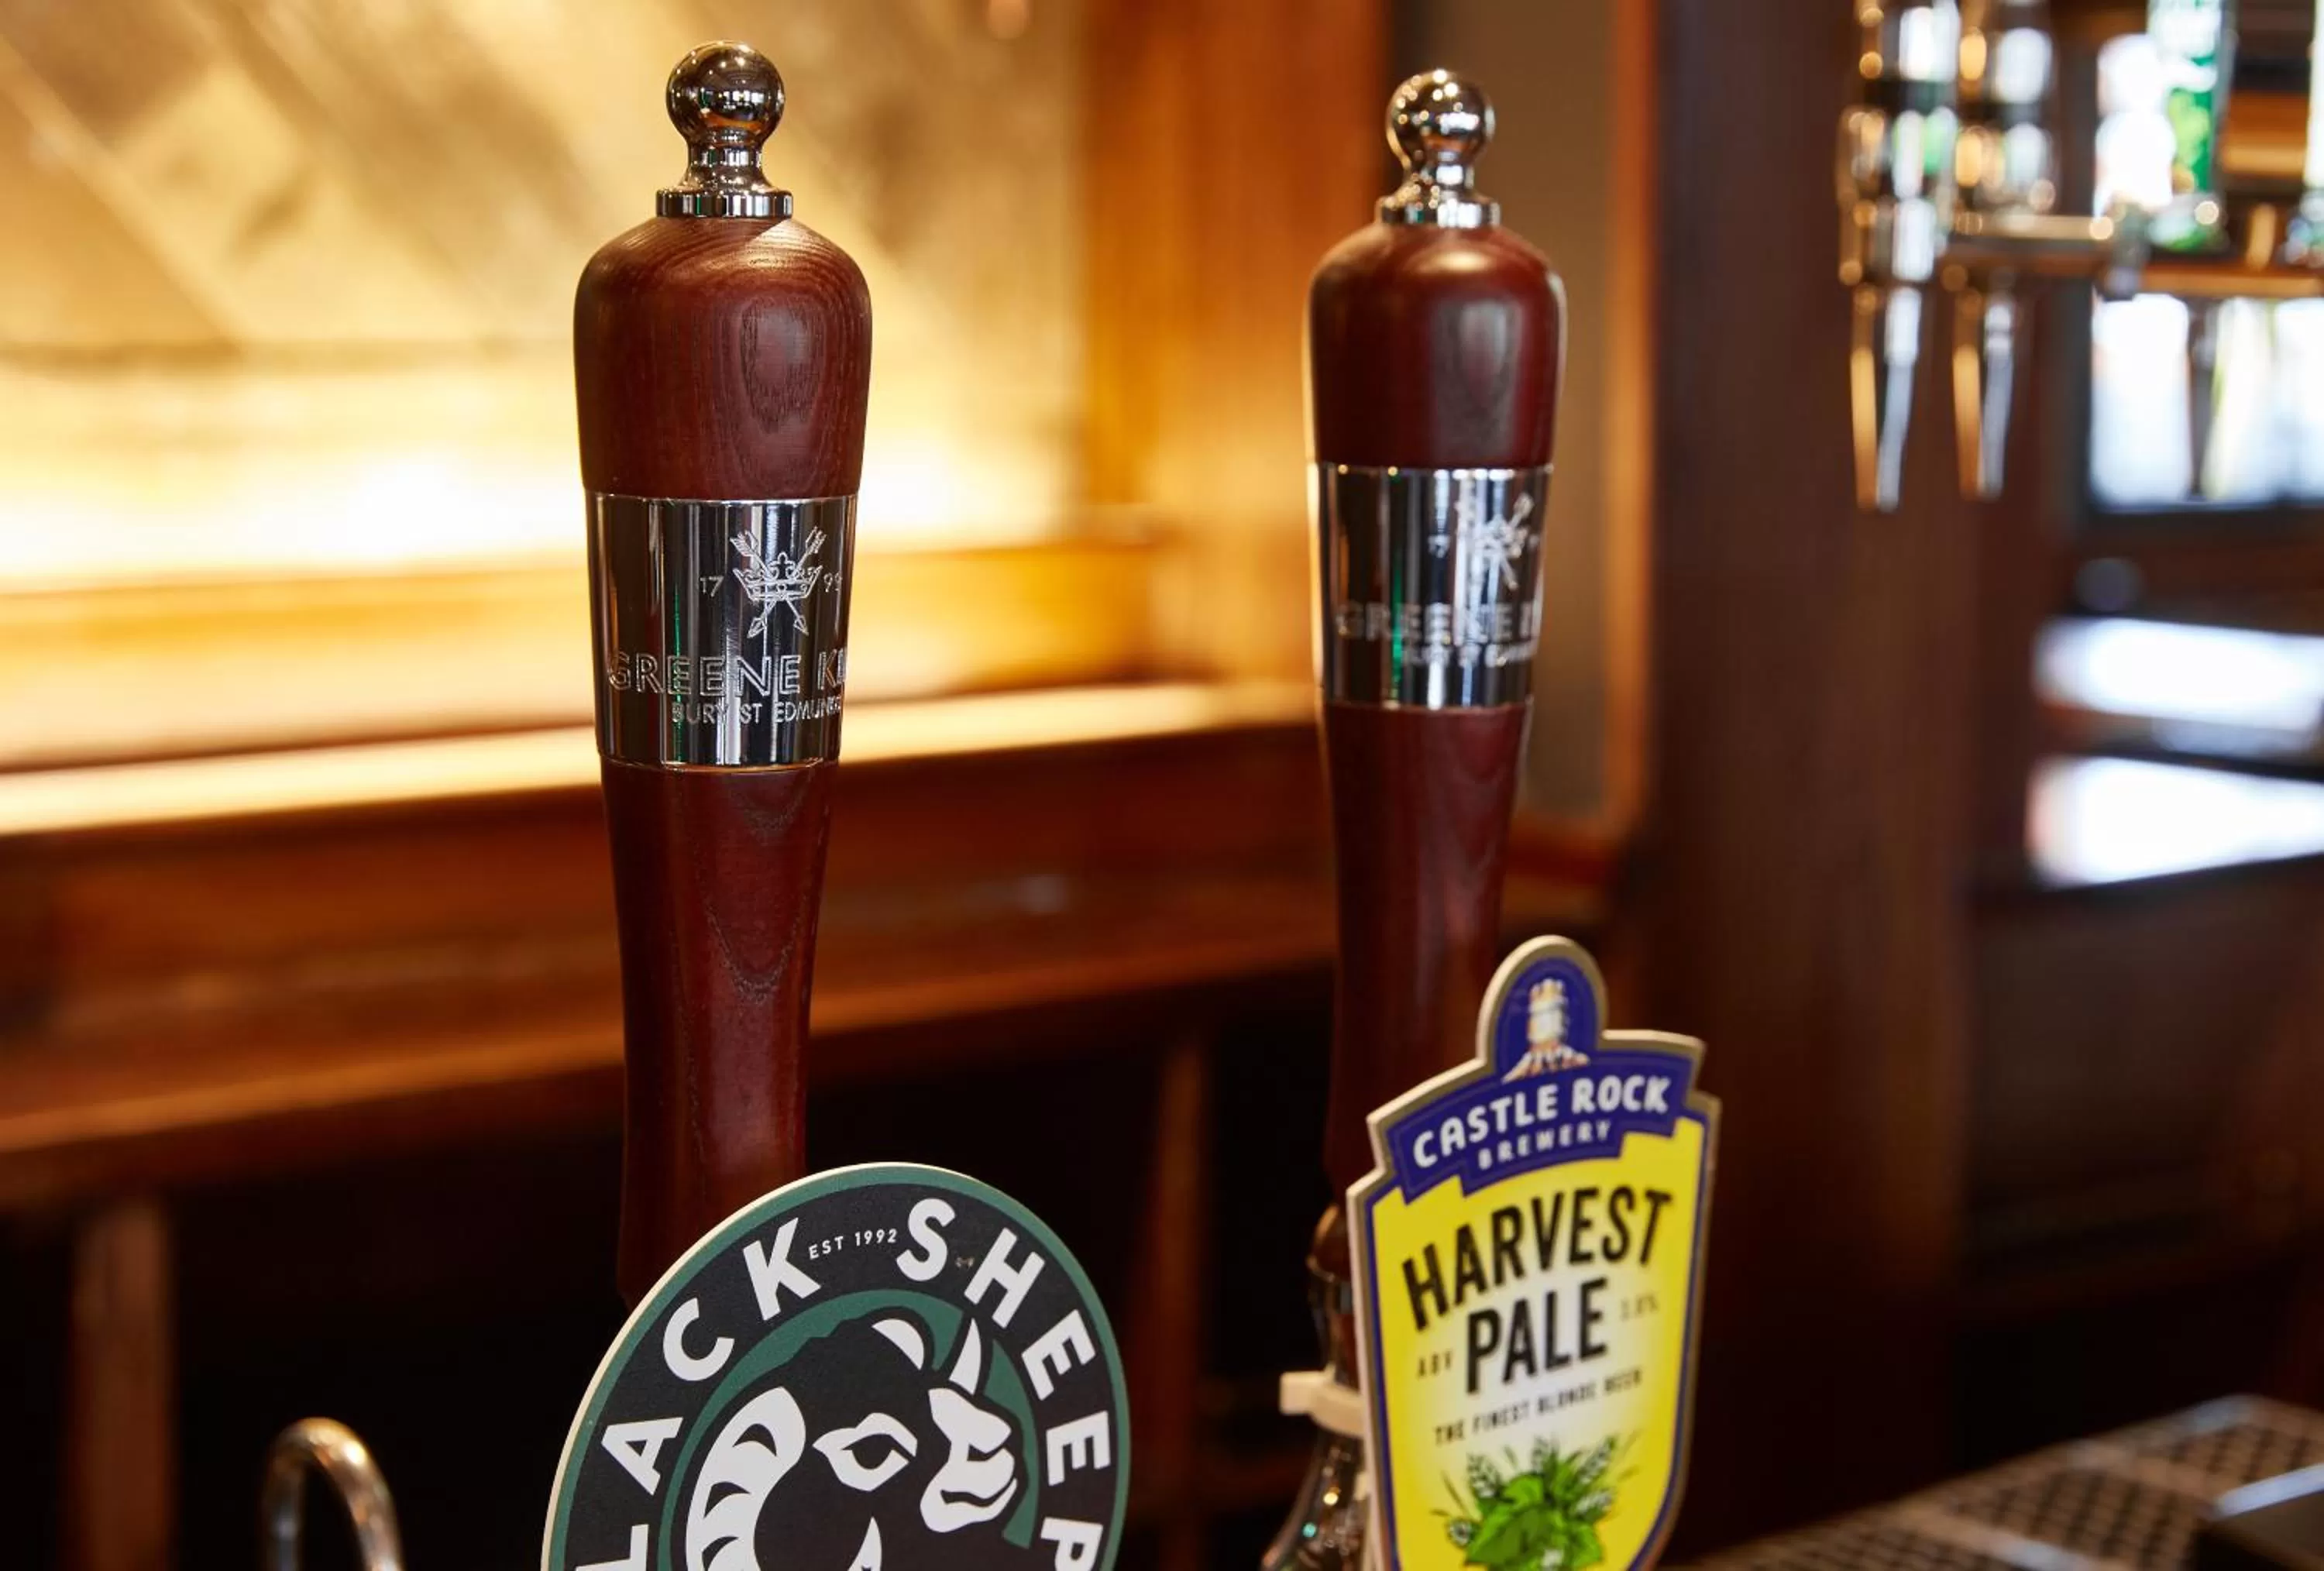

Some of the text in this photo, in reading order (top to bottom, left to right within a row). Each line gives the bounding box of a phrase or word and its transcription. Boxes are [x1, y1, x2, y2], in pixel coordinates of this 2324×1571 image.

[700, 575, 724, 597] 17
[607, 650, 802, 696] GREENE
[672, 701, 726, 725] BURY
[740, 703, 763, 724] ST
[1412, 1074, 1671, 1168] CASTLE ROCK
[1477, 1119, 1612, 1171] BREWERY
[808, 1228, 899, 1260] EST 1992
[1401, 1185, 1674, 1332] HARVEST
[1465, 1277, 1610, 1395] PALE
[896, 1198, 1111, 1571] SHEEP
[1417, 1349, 1453, 1380] ABV
[1434, 1418, 1465, 1446] THE
[1472, 1400, 1531, 1434] FINEST
